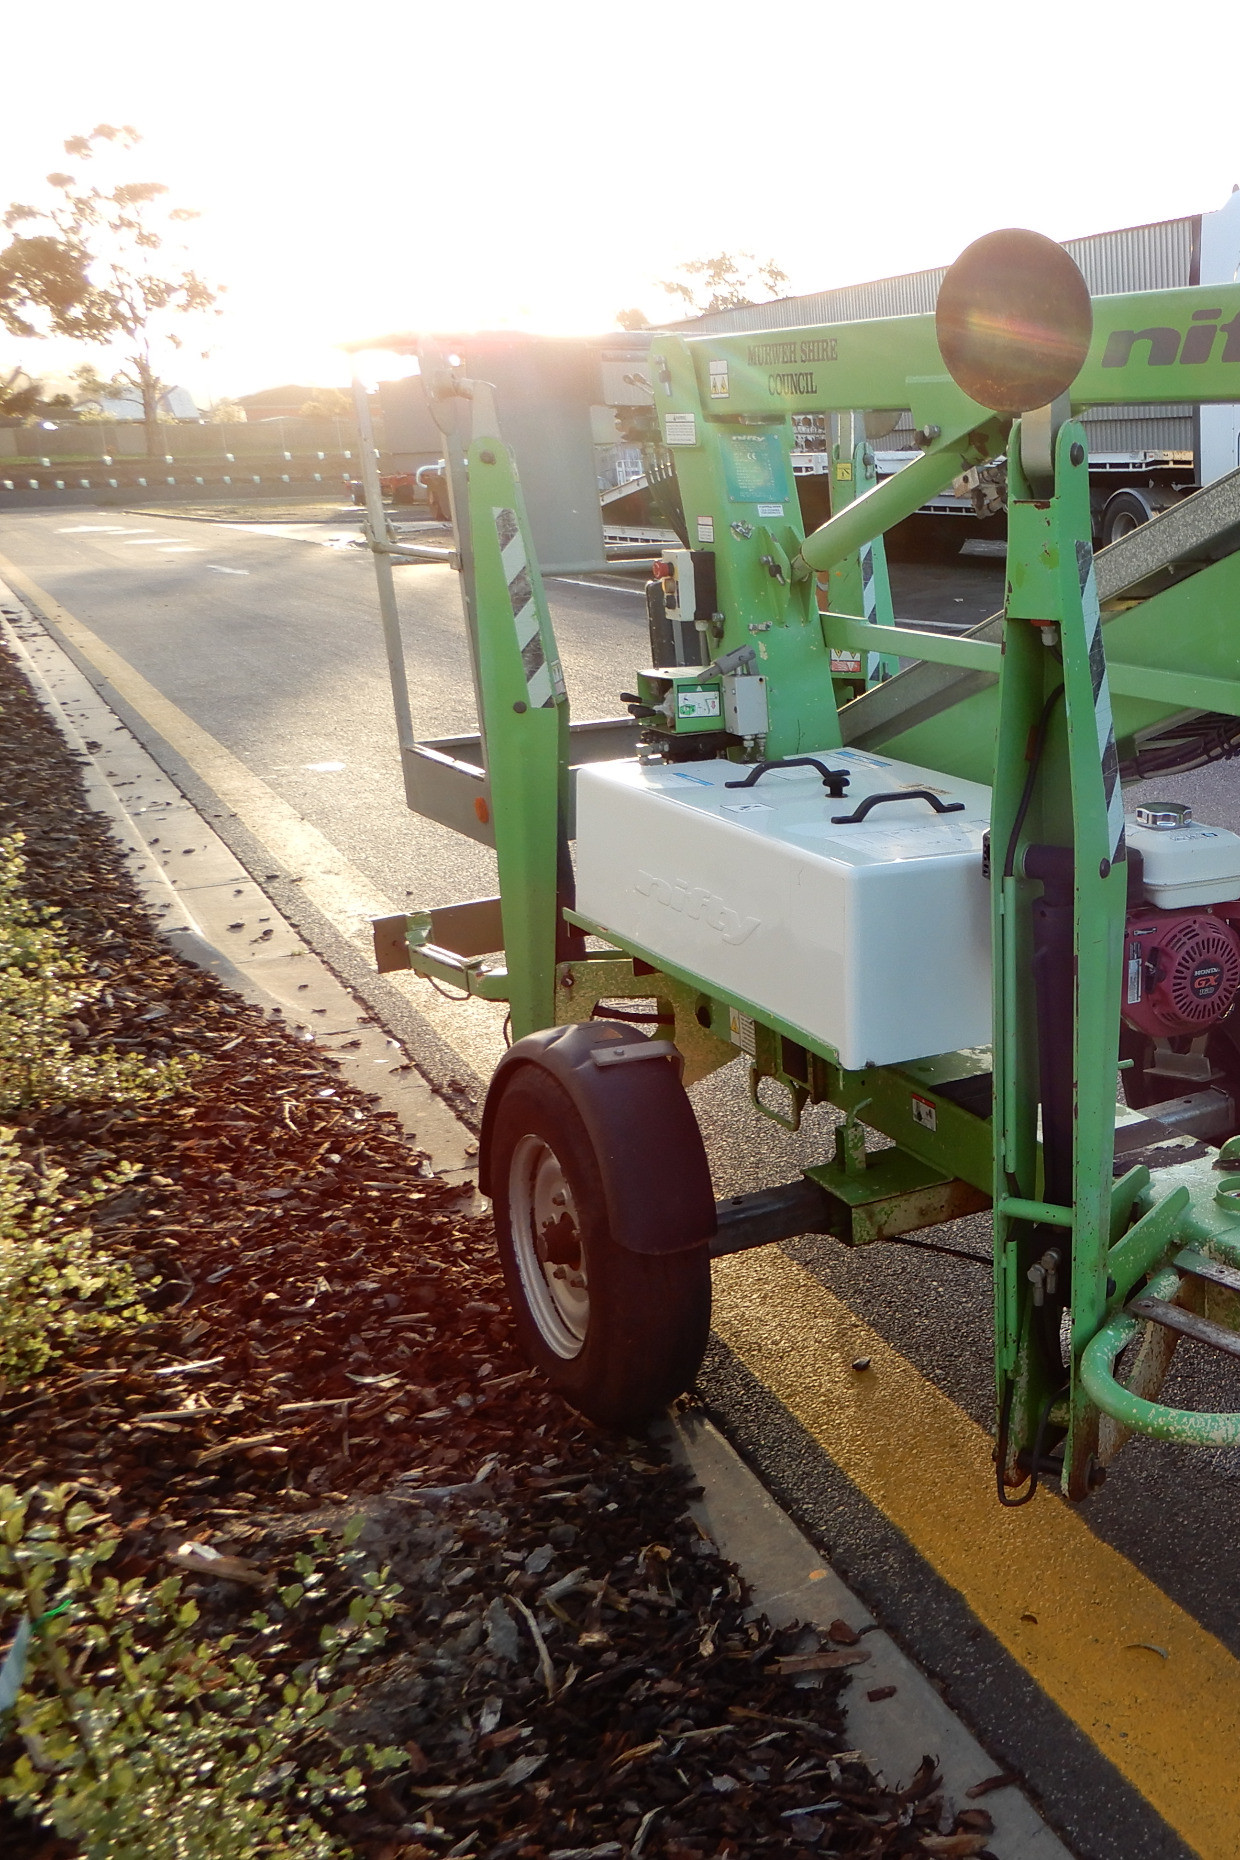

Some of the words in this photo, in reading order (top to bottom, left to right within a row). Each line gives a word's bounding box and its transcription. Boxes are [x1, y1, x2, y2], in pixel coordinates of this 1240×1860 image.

[747, 341, 798, 366] MURWEH
[800, 338, 838, 363] SHIRE
[768, 372, 817, 395] COUNCIL
[1194, 974, 1220, 989] GX
